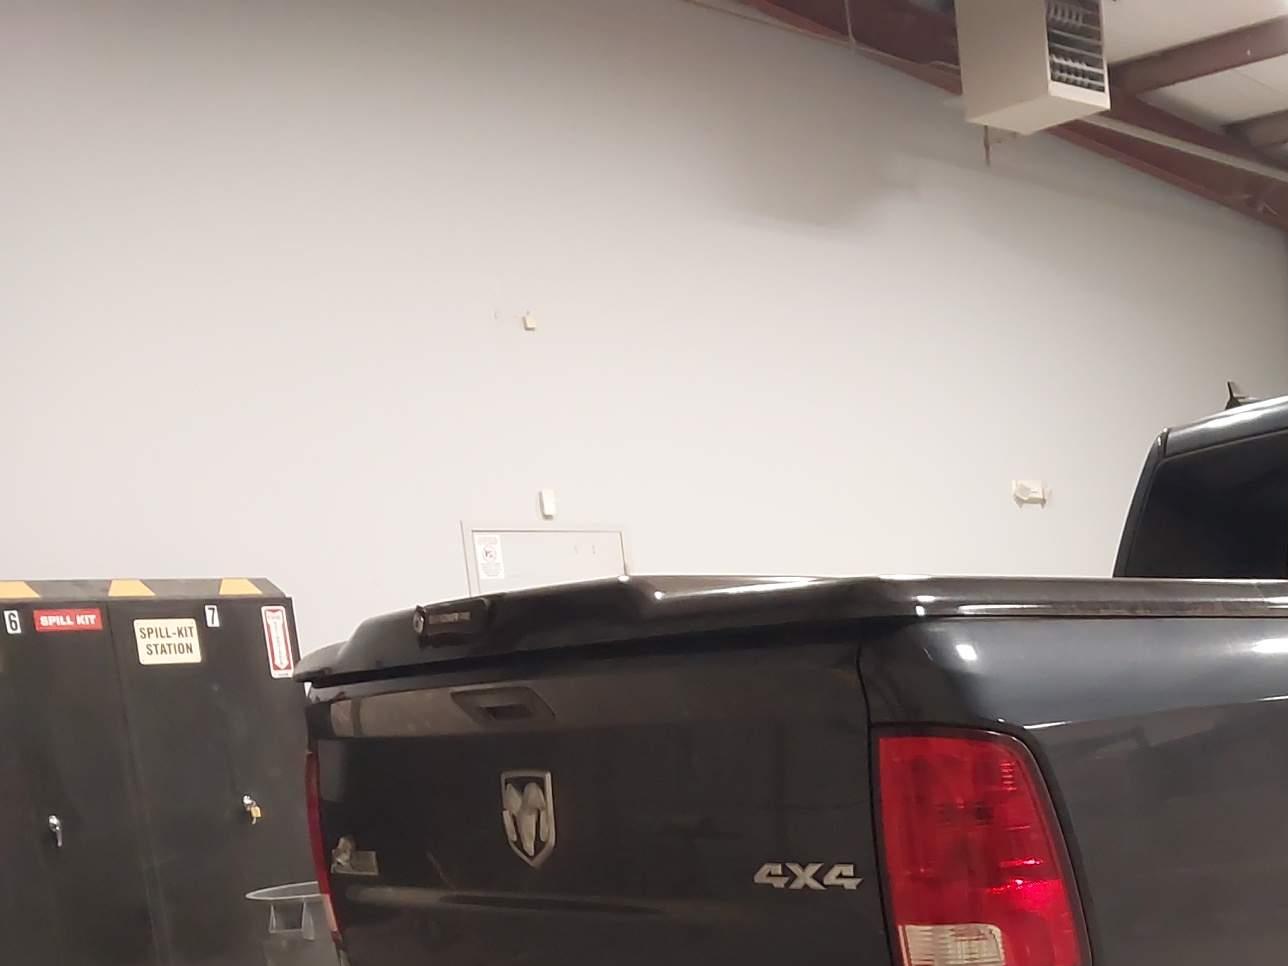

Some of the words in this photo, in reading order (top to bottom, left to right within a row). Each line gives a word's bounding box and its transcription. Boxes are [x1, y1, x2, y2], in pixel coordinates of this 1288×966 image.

[9, 612, 19, 632] 6
[40, 615, 74, 627] SPILL
[76, 614, 97, 626] KIT
[208, 607, 216, 625] 7
[139, 626, 194, 640] SPILL-KIT
[146, 643, 194, 656] STATION
